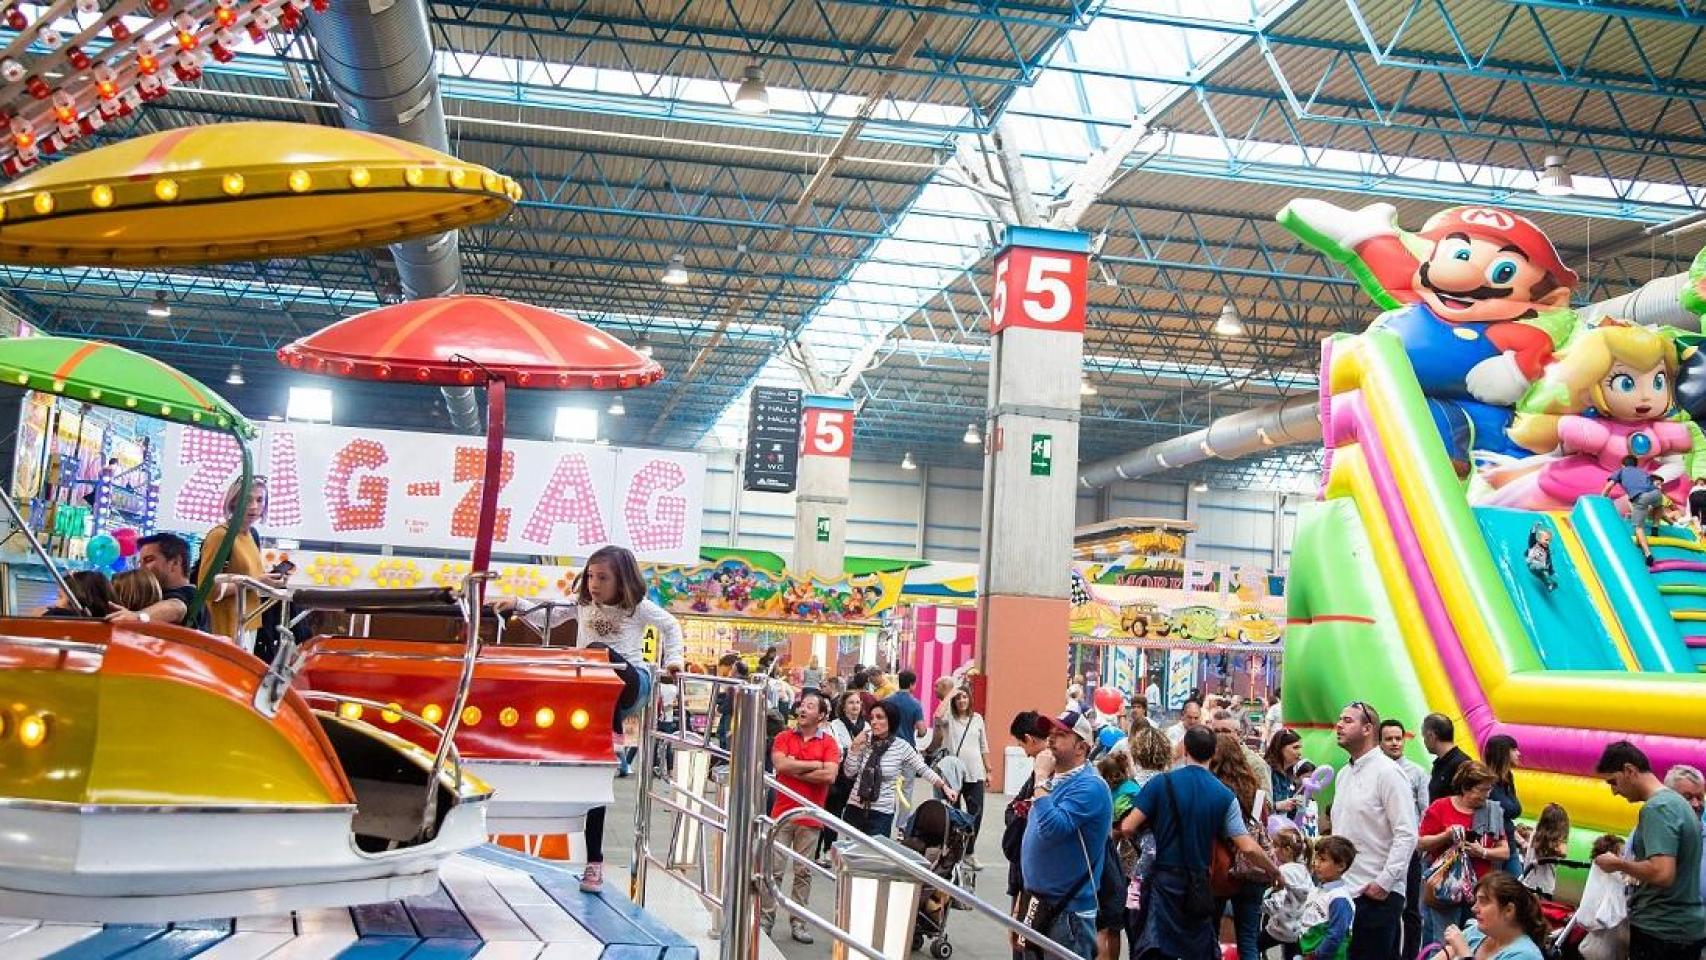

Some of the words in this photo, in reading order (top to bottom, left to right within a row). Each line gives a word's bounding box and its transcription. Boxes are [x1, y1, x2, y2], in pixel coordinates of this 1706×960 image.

[1022, 256, 1073, 324] 5
[767, 406, 790, 414] HALL
[767, 415, 789, 424] HALL
[813, 412, 844, 453] 5
[174, 426, 686, 552] ZIG-ZAG
